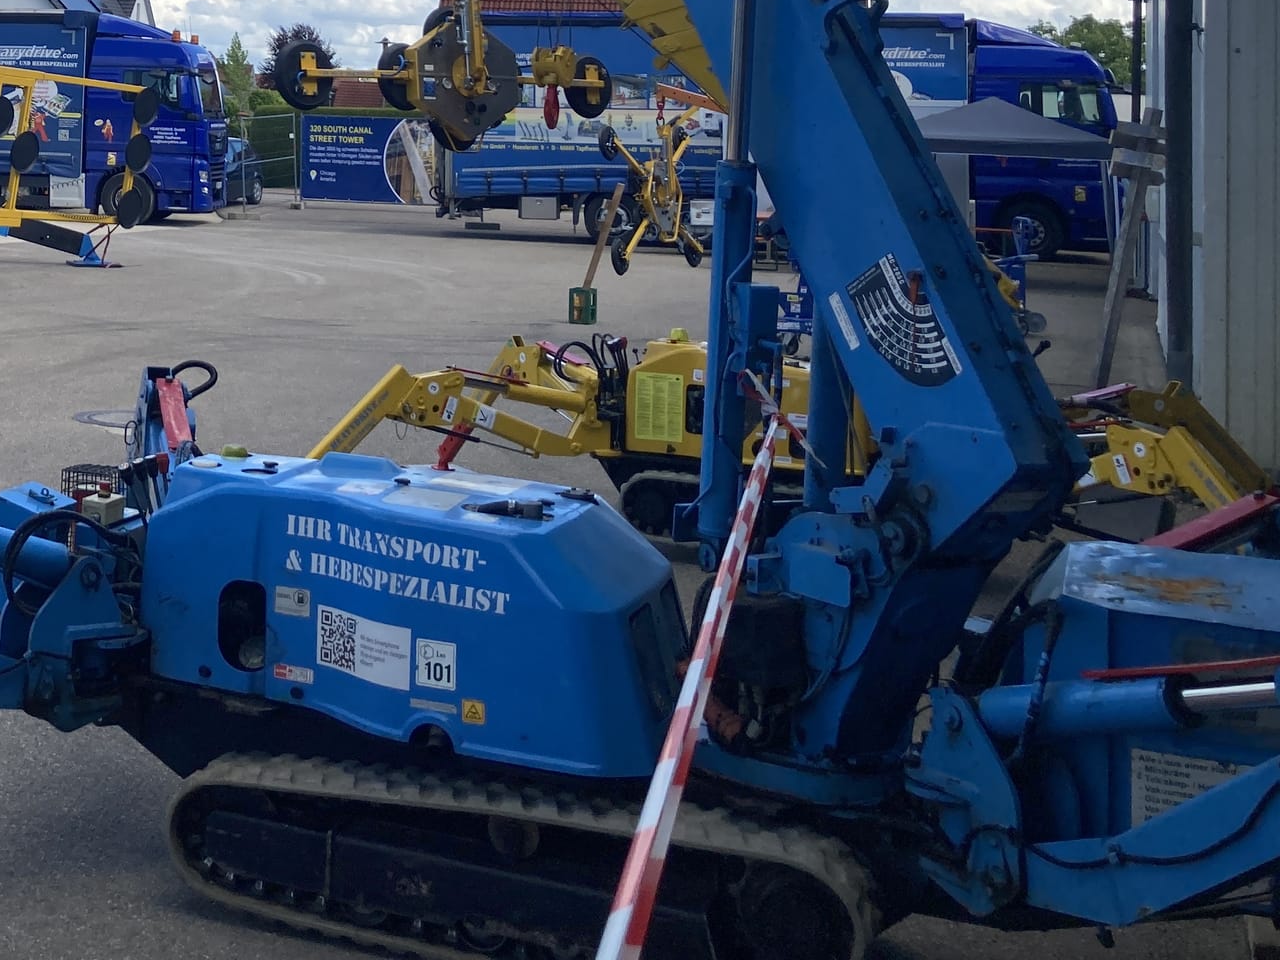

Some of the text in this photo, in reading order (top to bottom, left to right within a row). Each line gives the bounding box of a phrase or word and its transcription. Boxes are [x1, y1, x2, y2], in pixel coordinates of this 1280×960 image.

[309, 125, 374, 135] 320 SOUTH CANAL
[309, 135, 365, 144] STREET TOWER
[286, 514, 487, 572] IHR TRANSPORT-
[286, 549, 510, 615] & HEBESPEZIALIST
[424, 661, 451, 683] 101
